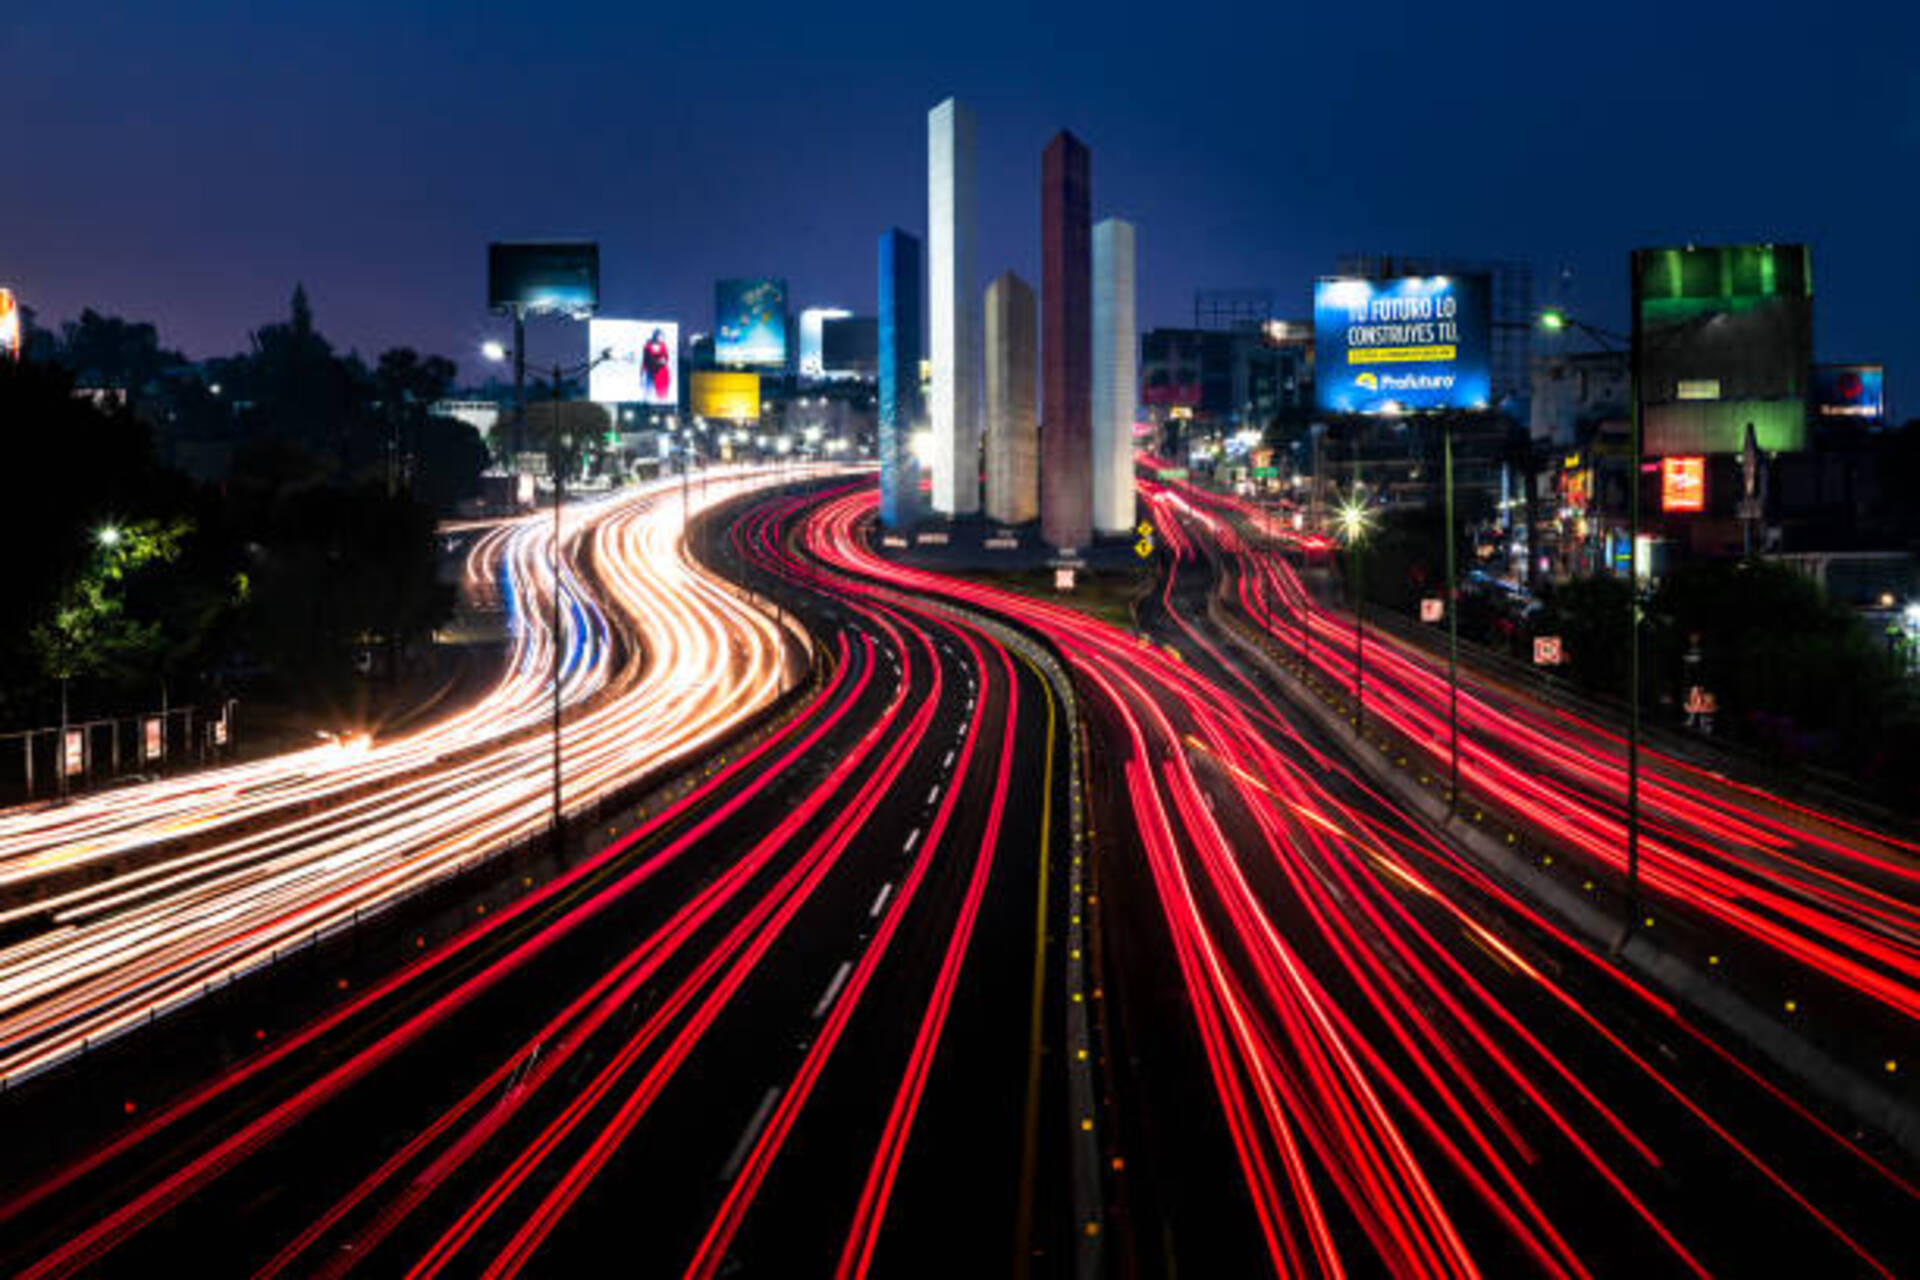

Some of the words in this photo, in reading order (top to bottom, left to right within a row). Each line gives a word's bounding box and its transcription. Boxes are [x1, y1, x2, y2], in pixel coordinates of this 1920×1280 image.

[1348, 297, 1368, 322] TU
[1372, 295, 1431, 321] FUTURO
[1436, 296, 1456, 318] LO
[1348, 322, 1435, 346] CONSTRUYES
[1380, 373, 1454, 390] Profuturo
